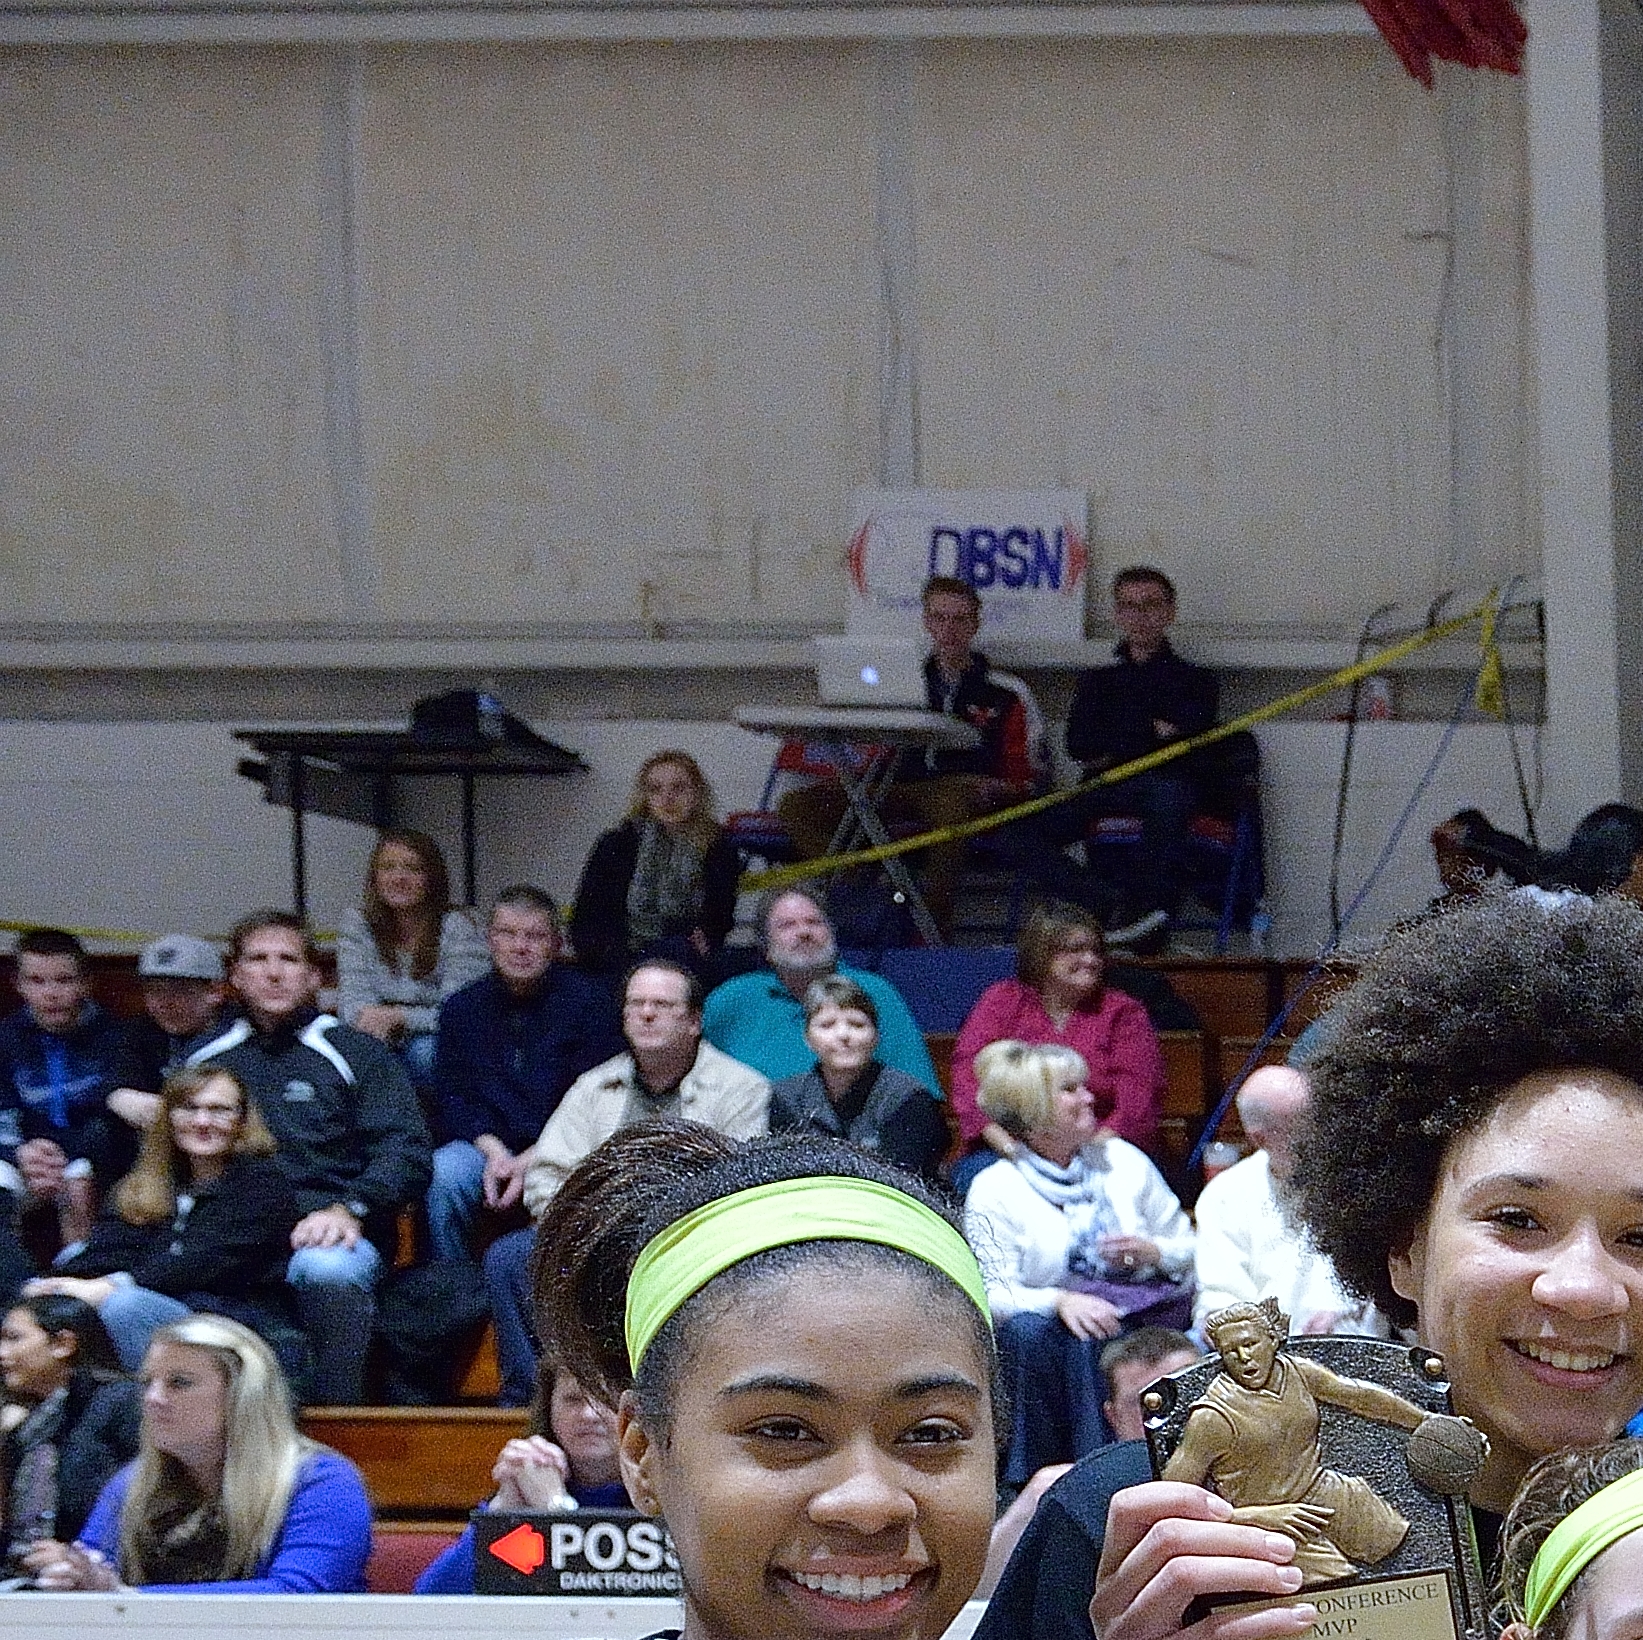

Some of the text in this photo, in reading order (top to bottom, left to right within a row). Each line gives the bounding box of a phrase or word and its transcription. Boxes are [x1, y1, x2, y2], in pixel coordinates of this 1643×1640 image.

[929, 526, 1064, 589] DBSN
[560, 1571, 683, 1590] DAKTRONIC
[1311, 1582, 1439, 1615] ONFERENCE
[1313, 1617, 1358, 1638] MVP
